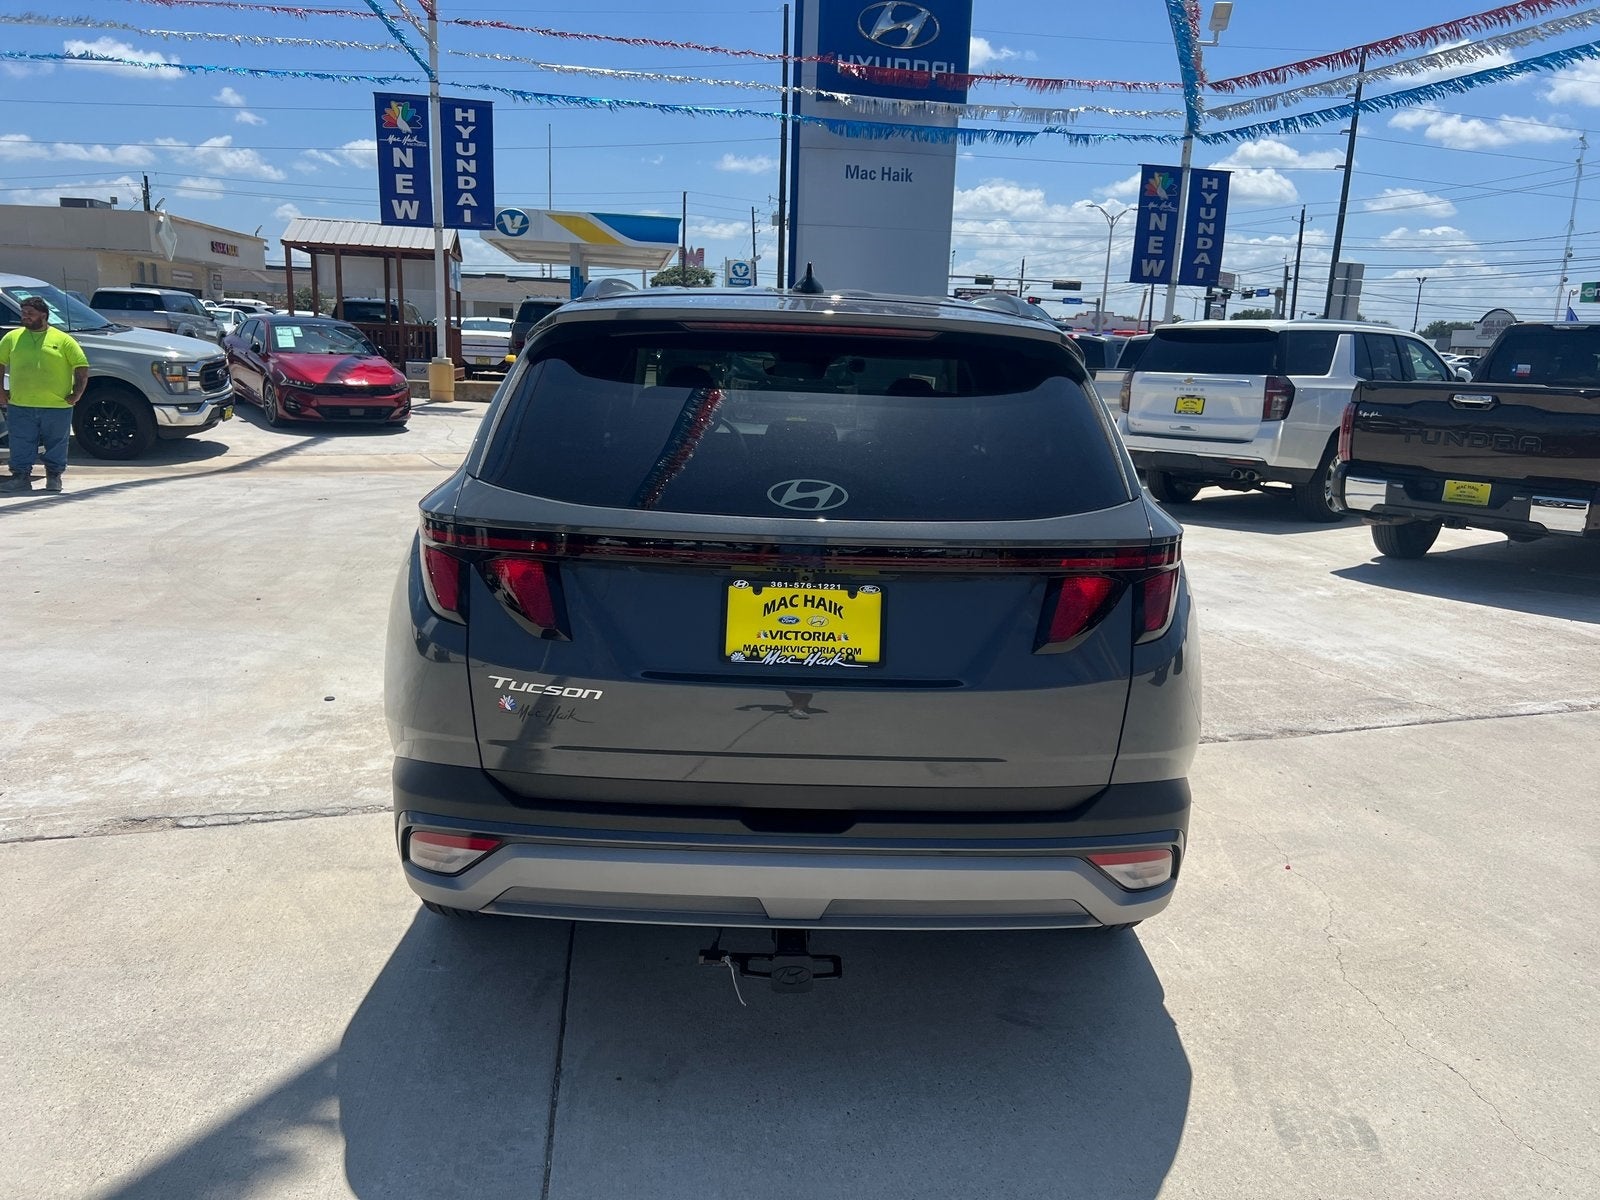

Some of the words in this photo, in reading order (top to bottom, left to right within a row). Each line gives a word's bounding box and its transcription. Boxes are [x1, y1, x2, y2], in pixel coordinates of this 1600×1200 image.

[455, 108, 478, 223] HYUNDAI
[845, 164, 877, 180] Mac
[881, 166, 914, 183] Haik
[391, 147, 420, 220] NEW
[1193, 177, 1219, 280] HYUNDAI
[1141, 212, 1168, 278] NEW
[1404, 428, 1543, 453] TUNDRA
[771, 581, 842, 590] 361-576-1221
[762, 594, 800, 617] MAC
[803, 594, 845, 620] HAIK
[768, 630, 837, 642] VICTORIA
[742, 644, 862, 656] MACHAIKVICTORIA.COM
[761, 650, 803, 666] Mac
[803, 651, 858, 667] Haik
